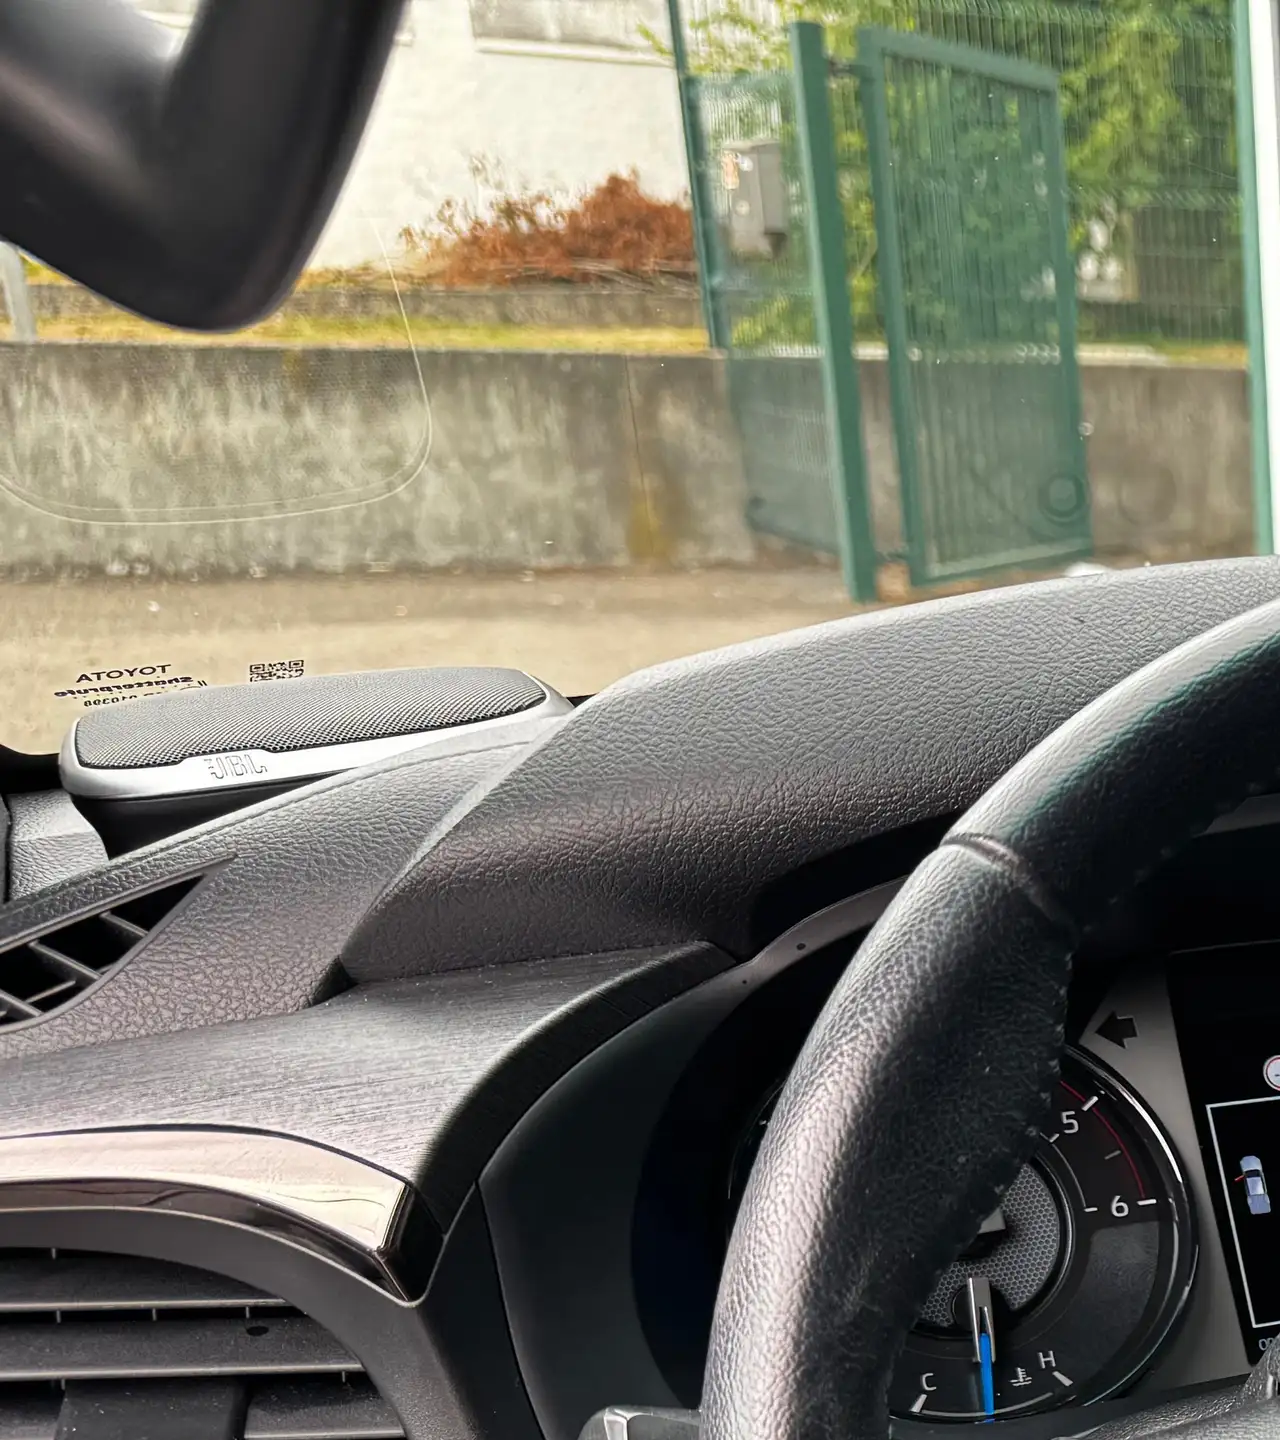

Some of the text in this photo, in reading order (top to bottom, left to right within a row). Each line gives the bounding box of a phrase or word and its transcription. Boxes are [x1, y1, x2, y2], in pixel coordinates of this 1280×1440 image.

[206, 753, 268, 781] JBL
[1062, 1111, 1080, 1134] 5
[1110, 1195, 1129, 1218] 6
[1038, 1351, 1057, 1369] H
[920, 1372, 935, 1391] C
